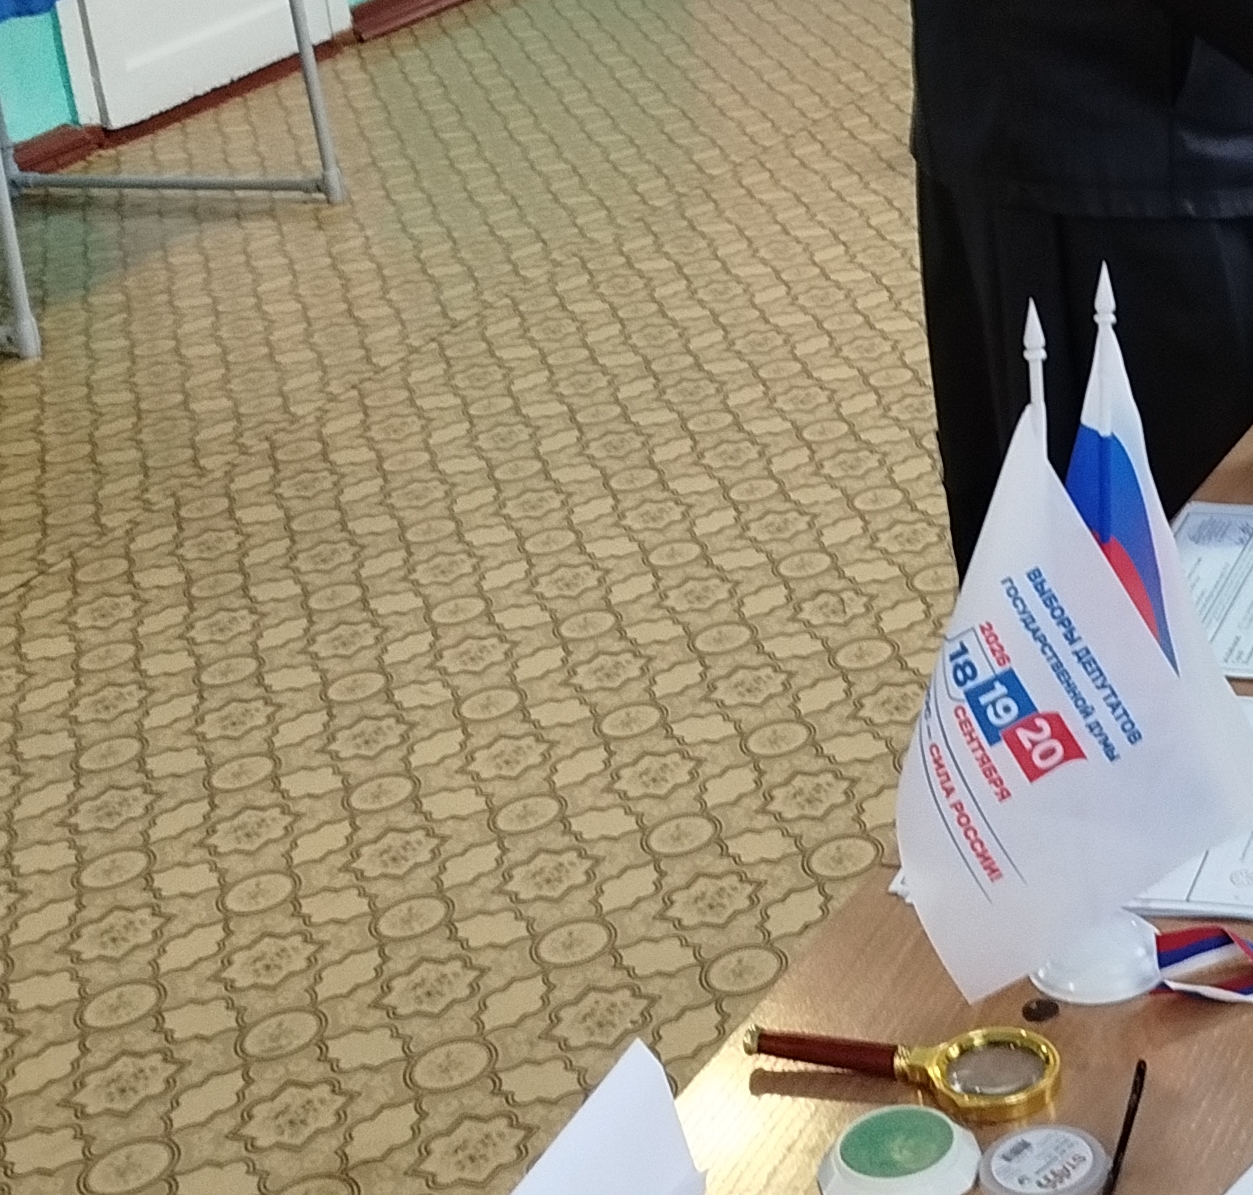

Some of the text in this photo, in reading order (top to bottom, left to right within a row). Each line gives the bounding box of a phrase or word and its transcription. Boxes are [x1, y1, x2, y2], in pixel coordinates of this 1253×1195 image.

[948, 640, 1065, 771] 18 19 20
[979, 621, 1012, 668] 2026
[1000, 576, 1121, 763] ГОСУДАРСТВЕННОЙ ДУМЫ
[1026, 566, 1142, 746] ВЫБОРЫ ДЕПУТАТОВ
[928, 742, 956, 800] СИЛА
[949, 800, 1004, 884] РОССИИ!
[953, 704, 1012, 803] СЕНТЯБРЯ
